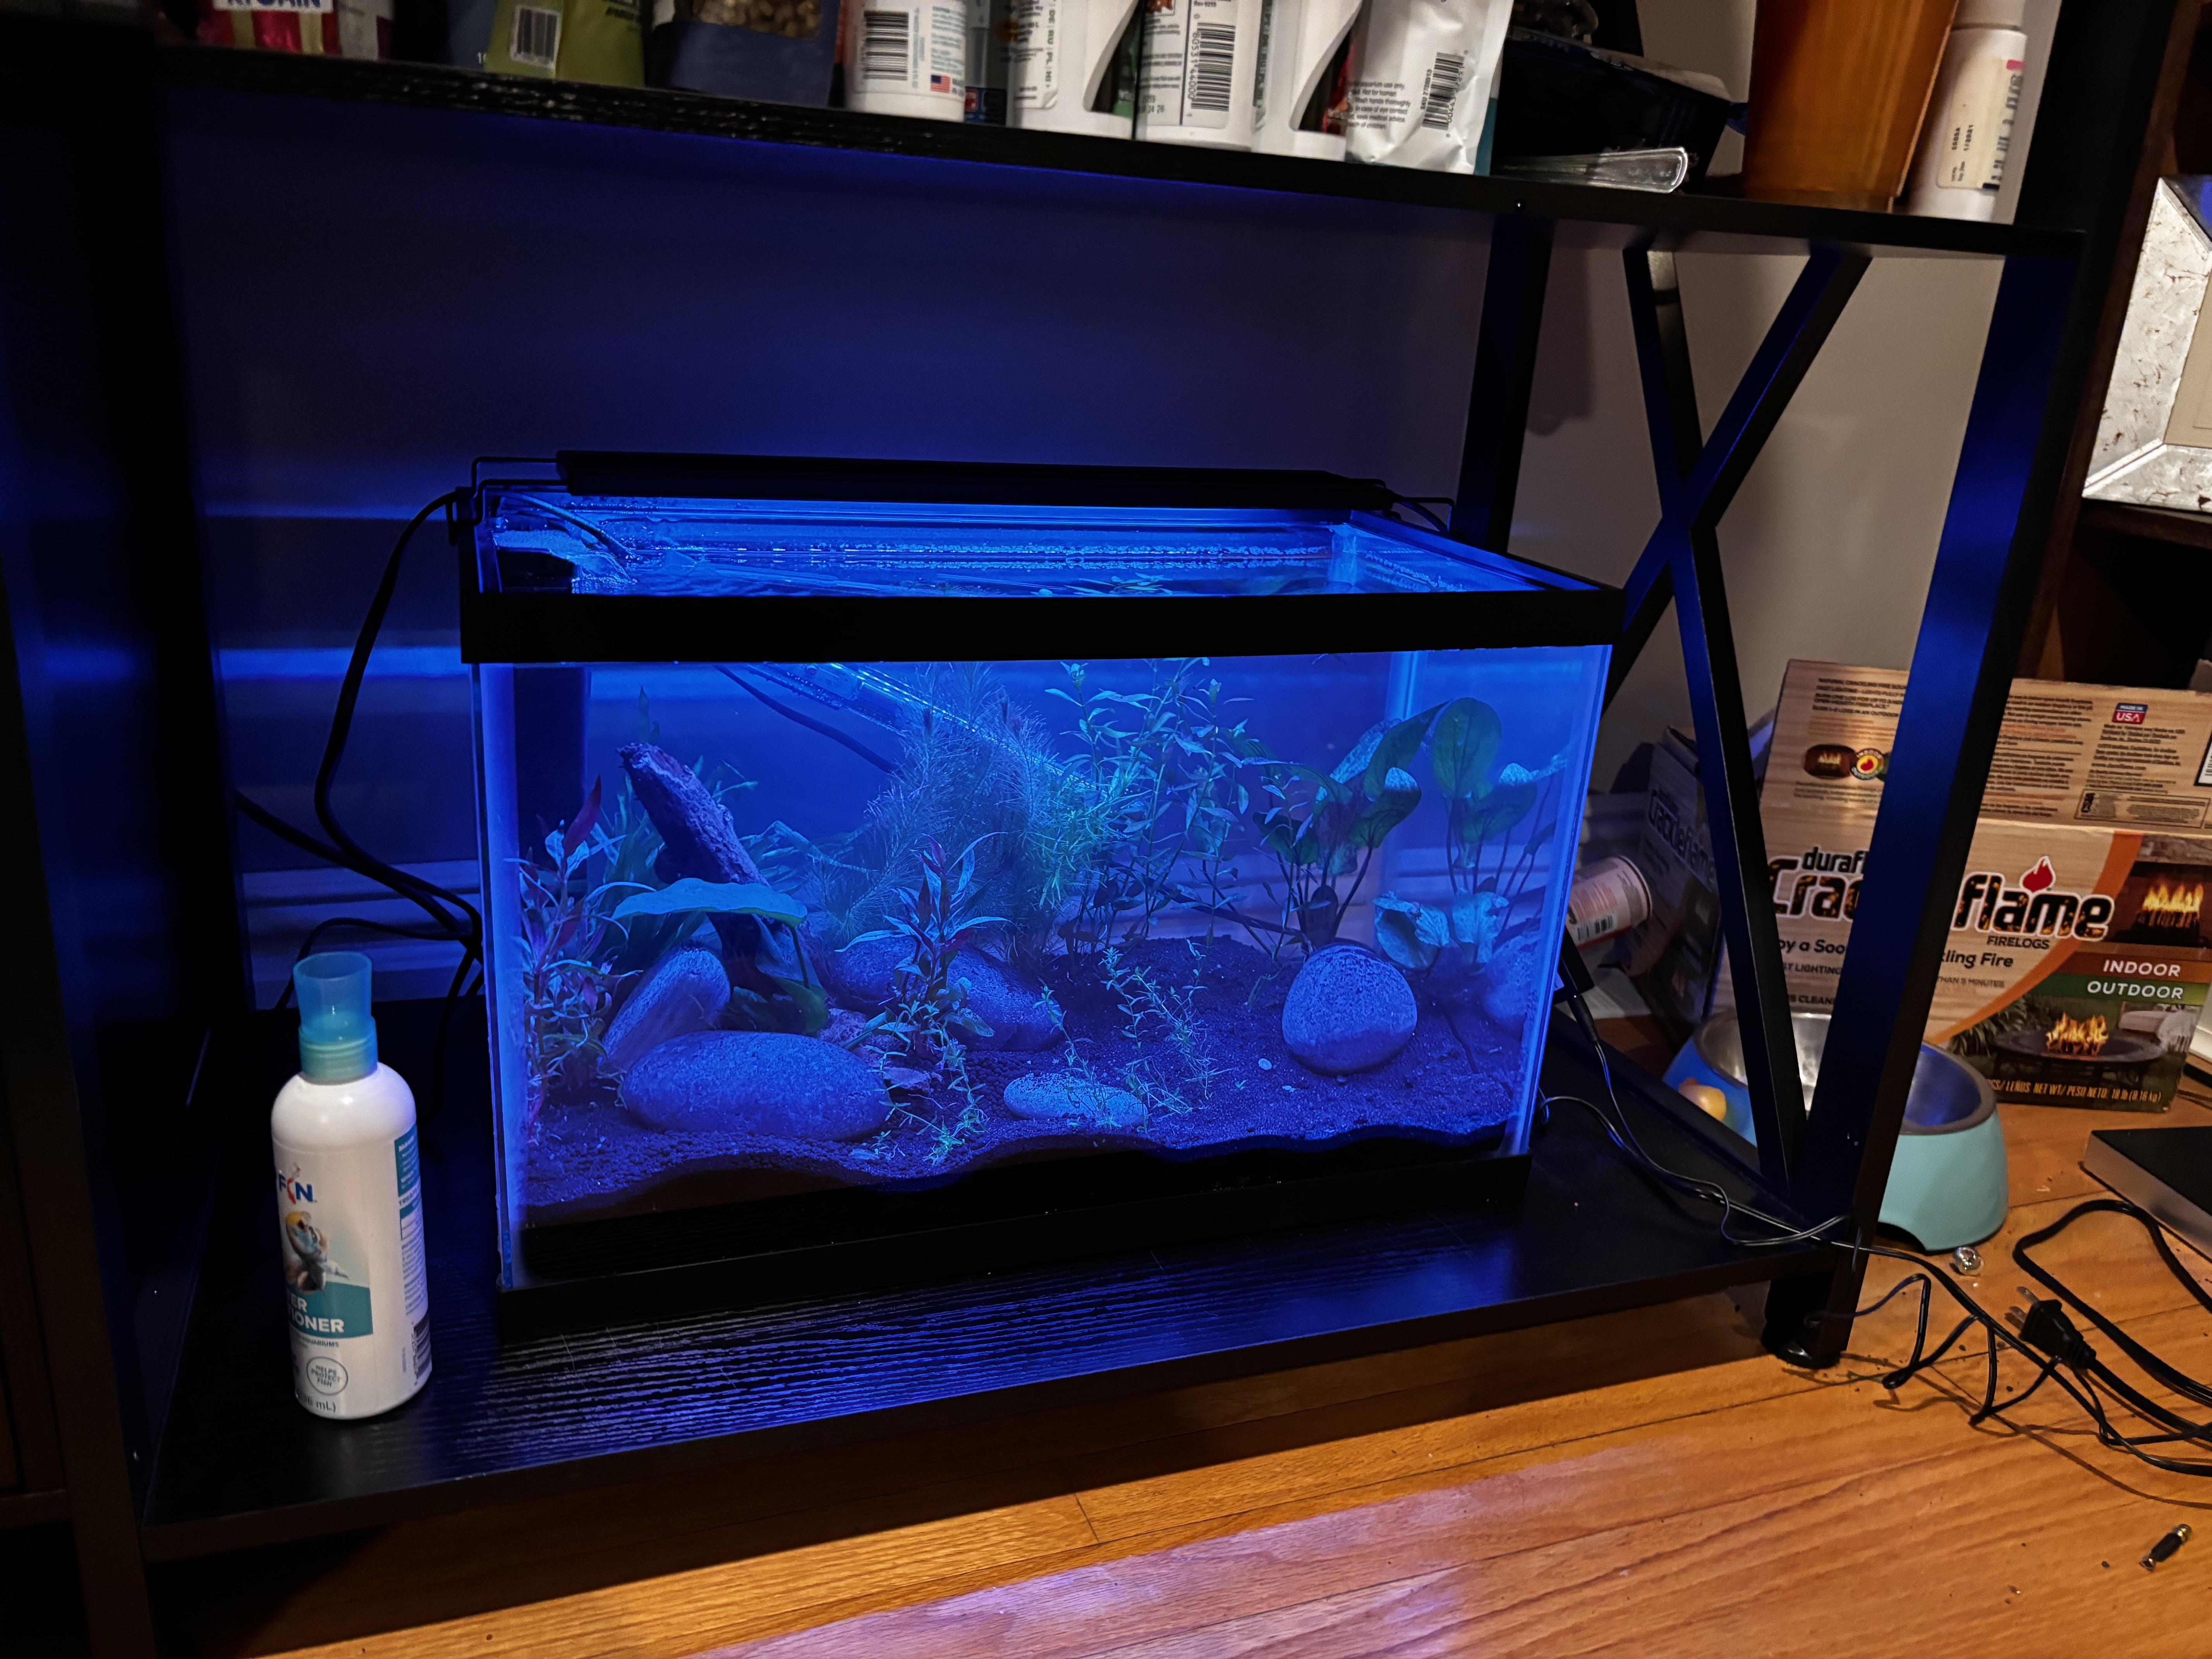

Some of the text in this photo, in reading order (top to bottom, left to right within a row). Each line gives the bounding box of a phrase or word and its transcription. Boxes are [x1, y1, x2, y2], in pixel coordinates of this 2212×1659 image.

[2116, 712, 2140, 723] USA
[1987, 935, 2050, 950] FIRELOGS
[1799, 941, 1810, 951] a
[1942, 949, 1977, 969] ling
[1980, 952, 2014, 968] Fire
[2103, 959, 2181, 977] INDOOR
[1968, 978, 2005, 989] MINUTES
[2087, 980, 2184, 1000] OUTDOOR
[2033, 1082, 2049, 1094] NET
[2066, 1085, 2087, 1097] PESO
